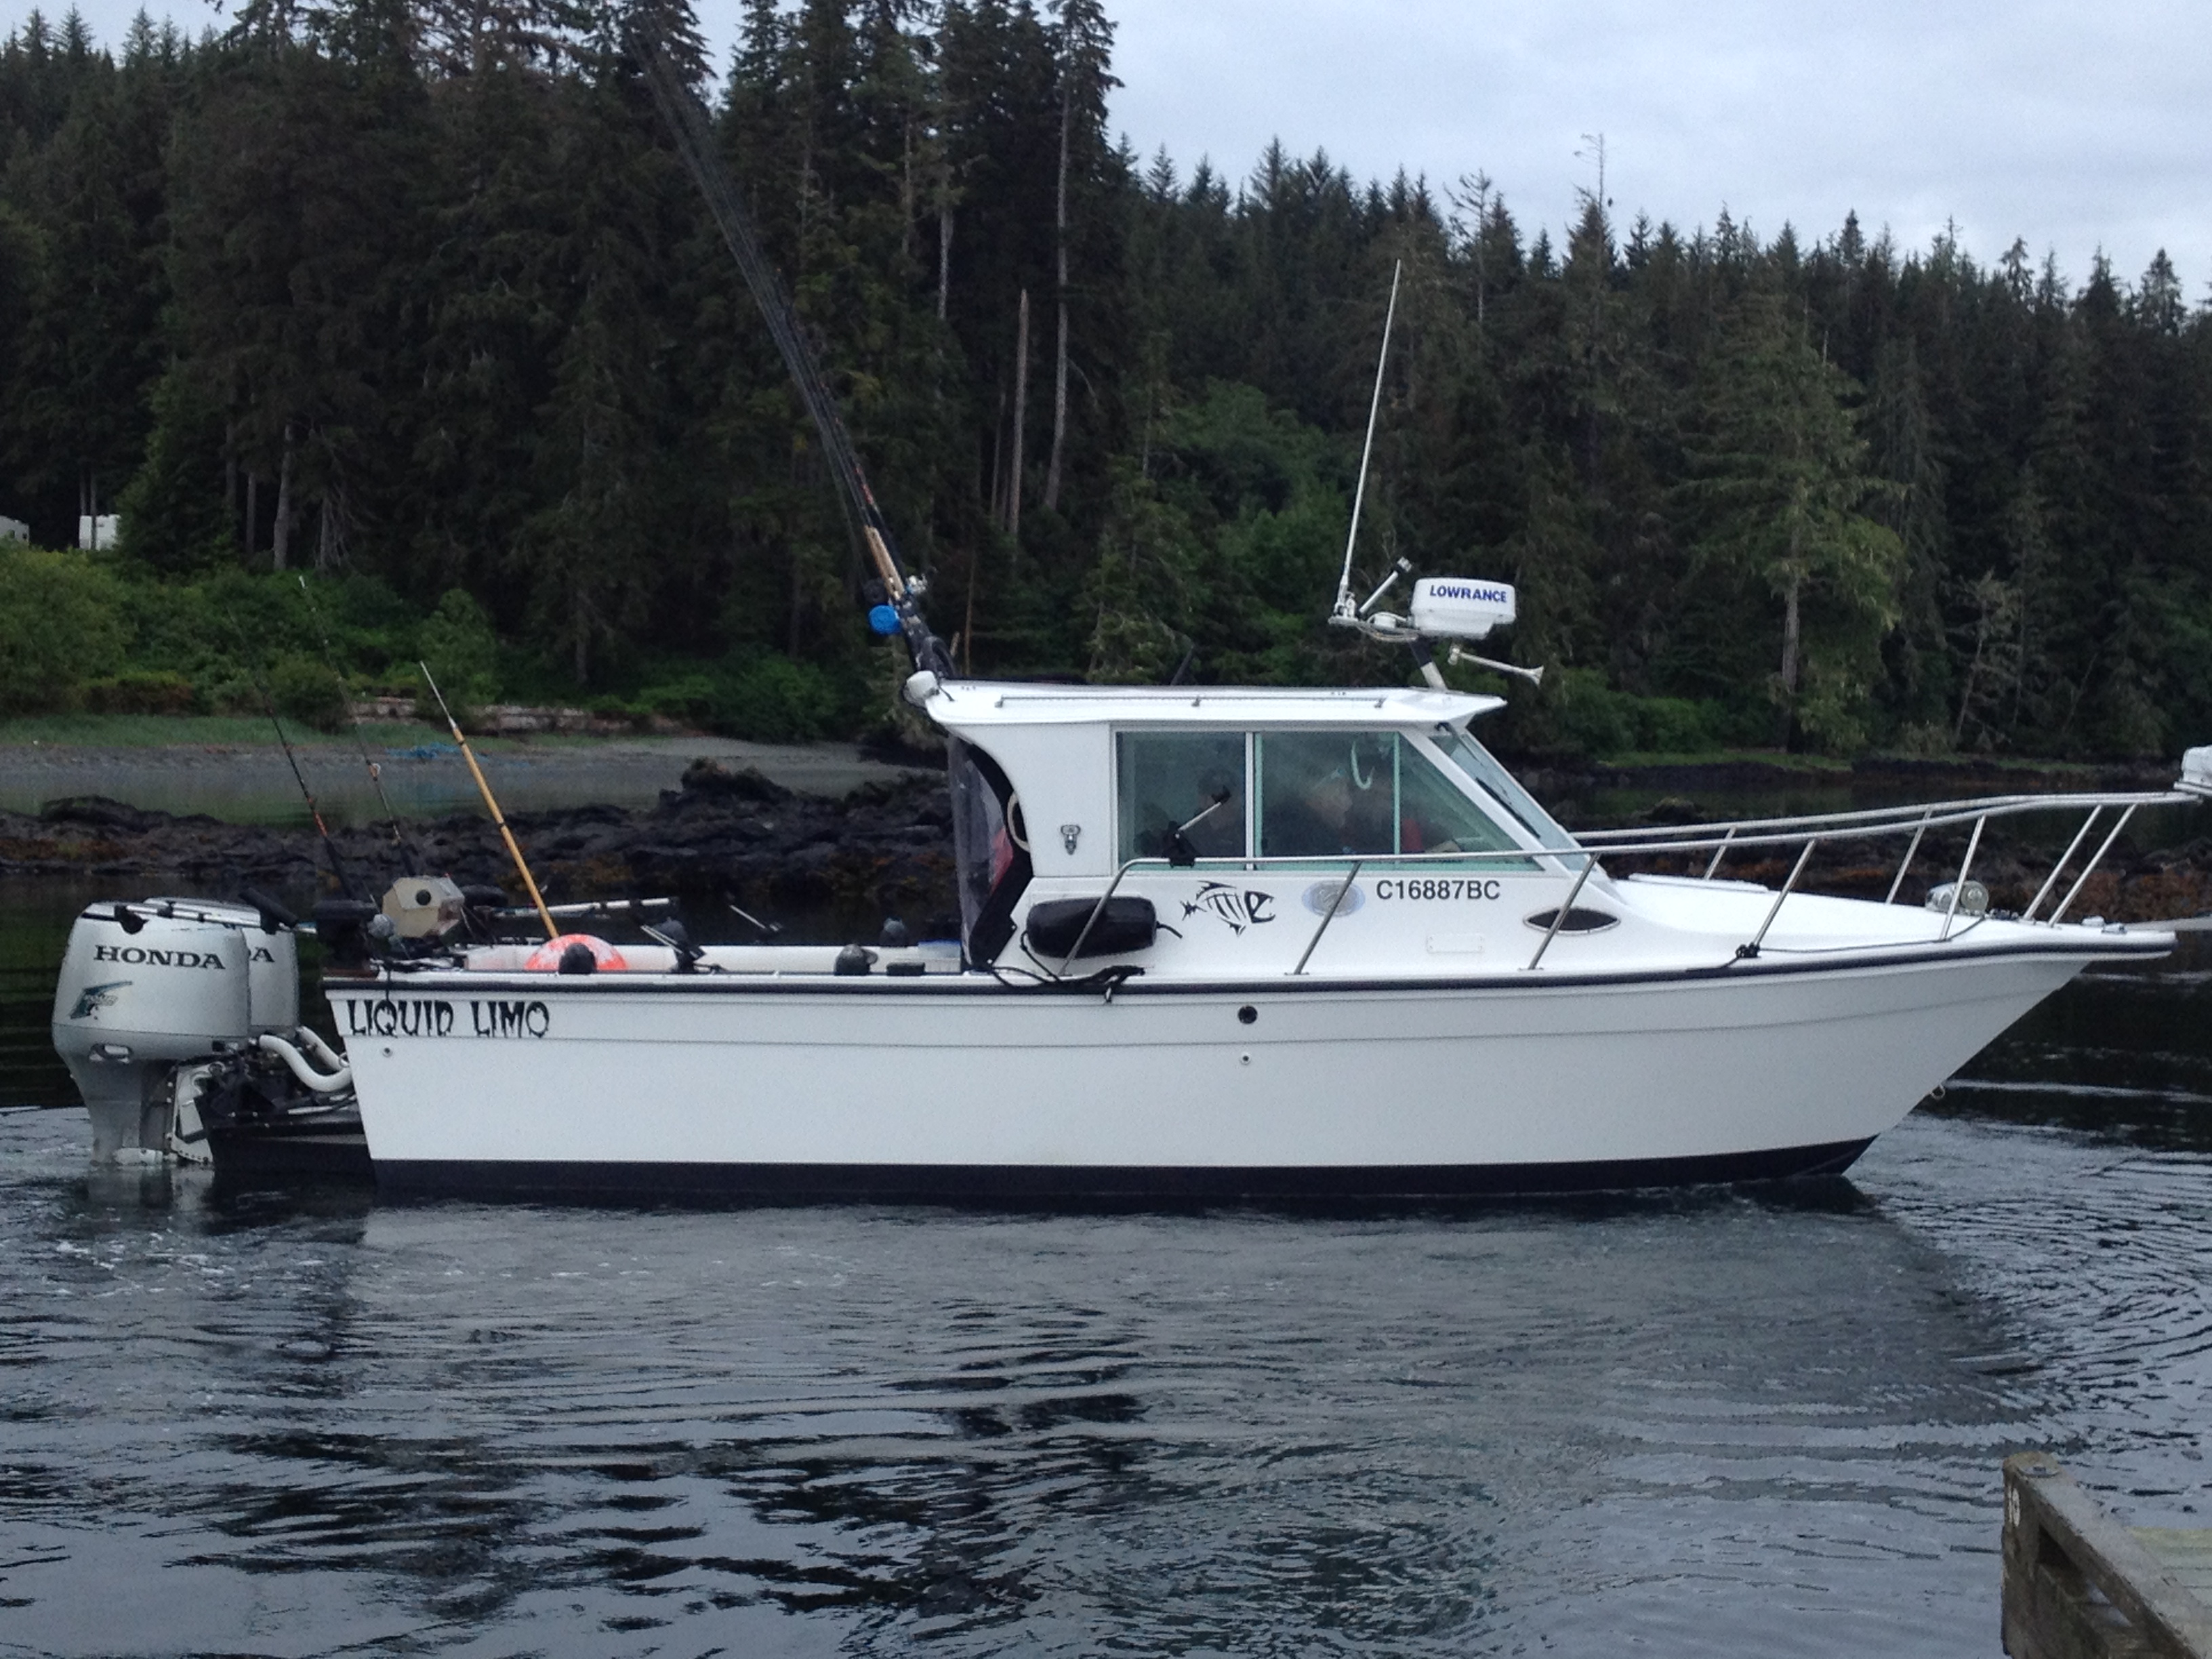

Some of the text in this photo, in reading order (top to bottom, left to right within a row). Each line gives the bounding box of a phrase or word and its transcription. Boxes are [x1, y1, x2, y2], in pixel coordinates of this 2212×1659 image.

[1429, 584, 1507, 602] LOWRANCE
[1376, 879, 1501, 900] C16887BC
[94, 944, 226, 970] HONDA
[347, 999, 550, 1038] LIQUID LIMO
